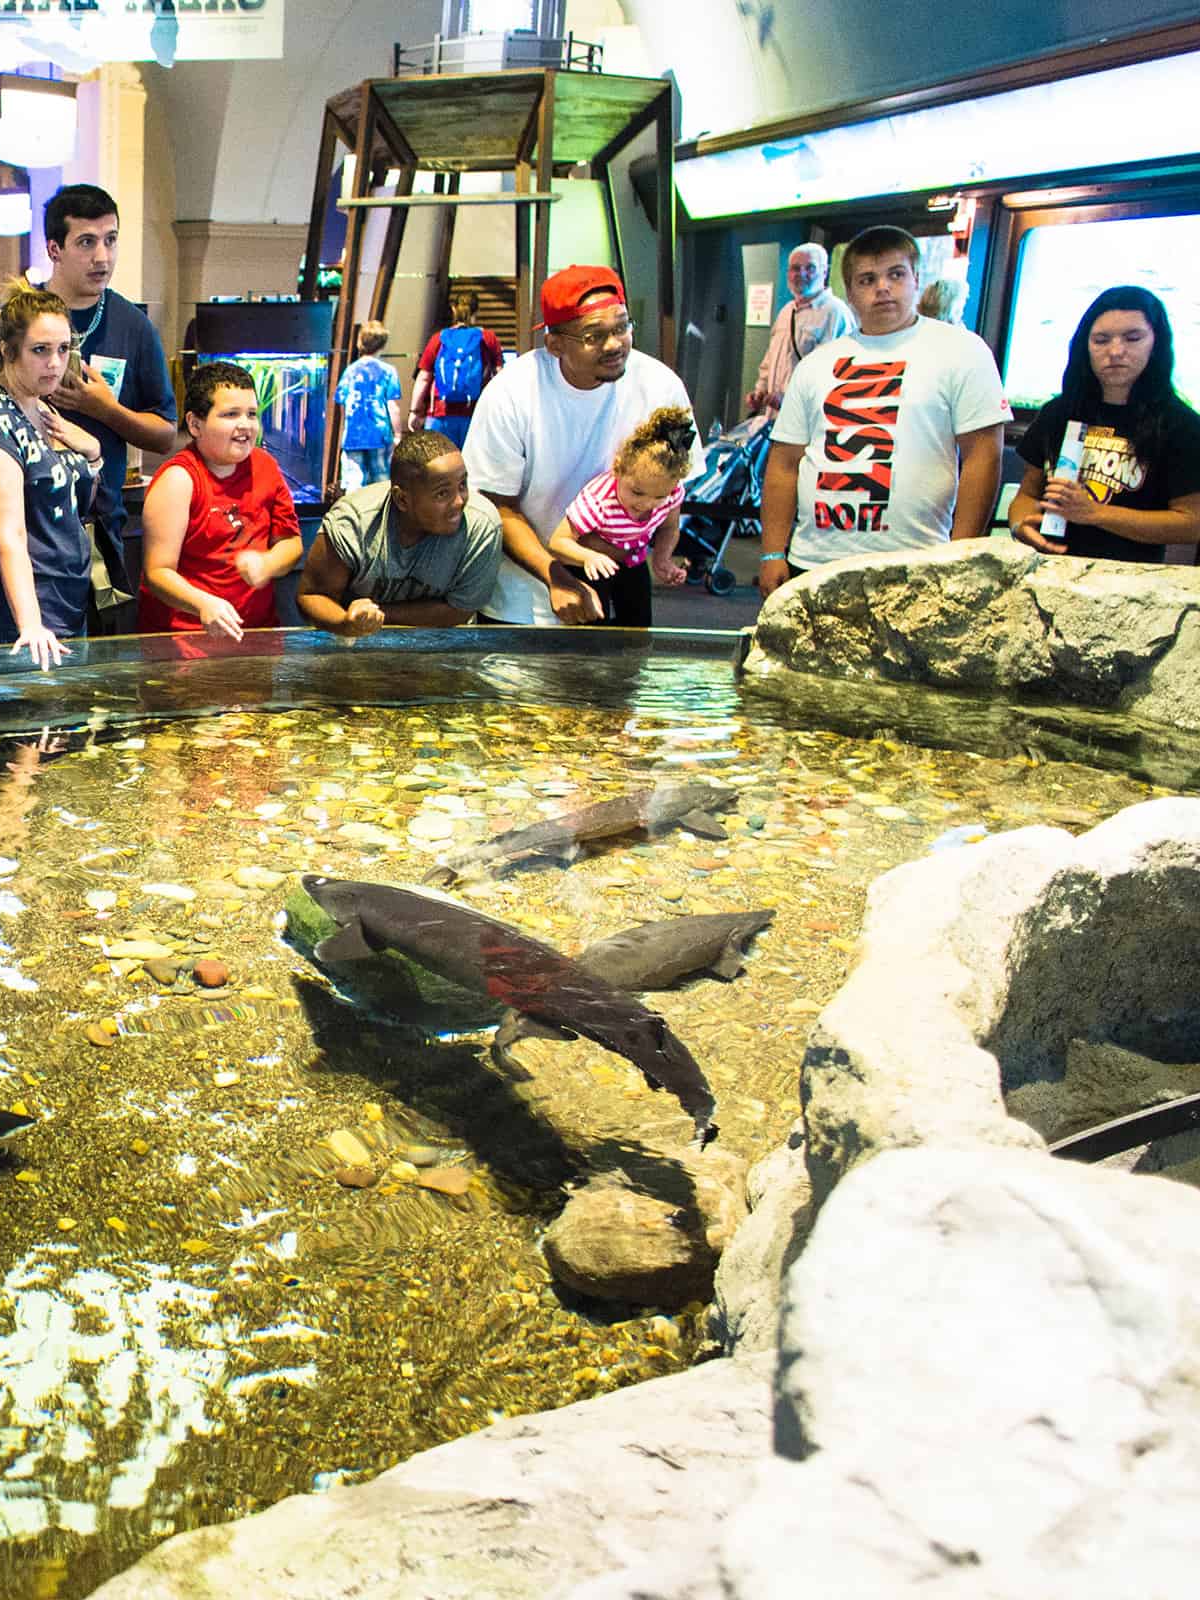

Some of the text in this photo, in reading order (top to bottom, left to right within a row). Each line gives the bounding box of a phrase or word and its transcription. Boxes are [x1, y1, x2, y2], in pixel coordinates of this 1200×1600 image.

[816, 356, 907, 501] JUST
[814, 501, 889, 532] DO IT.
